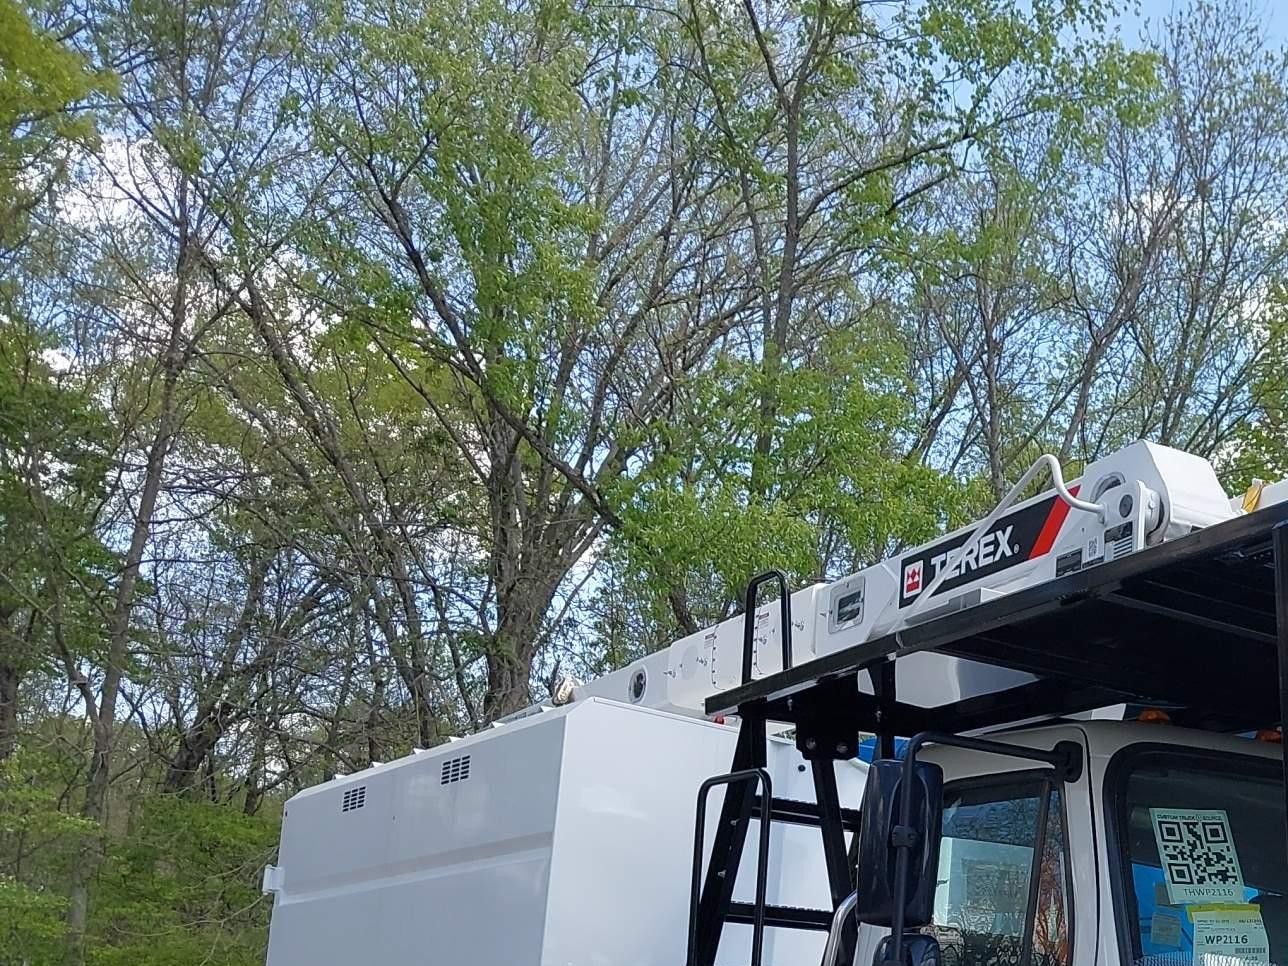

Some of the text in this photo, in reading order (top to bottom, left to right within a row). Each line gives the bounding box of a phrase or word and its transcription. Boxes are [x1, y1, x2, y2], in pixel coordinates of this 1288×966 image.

[930, 524, 1014, 581] TEREX
[1183, 888, 1234, 897] THWP2116
[1204, 934, 1249, 945] WP2116
